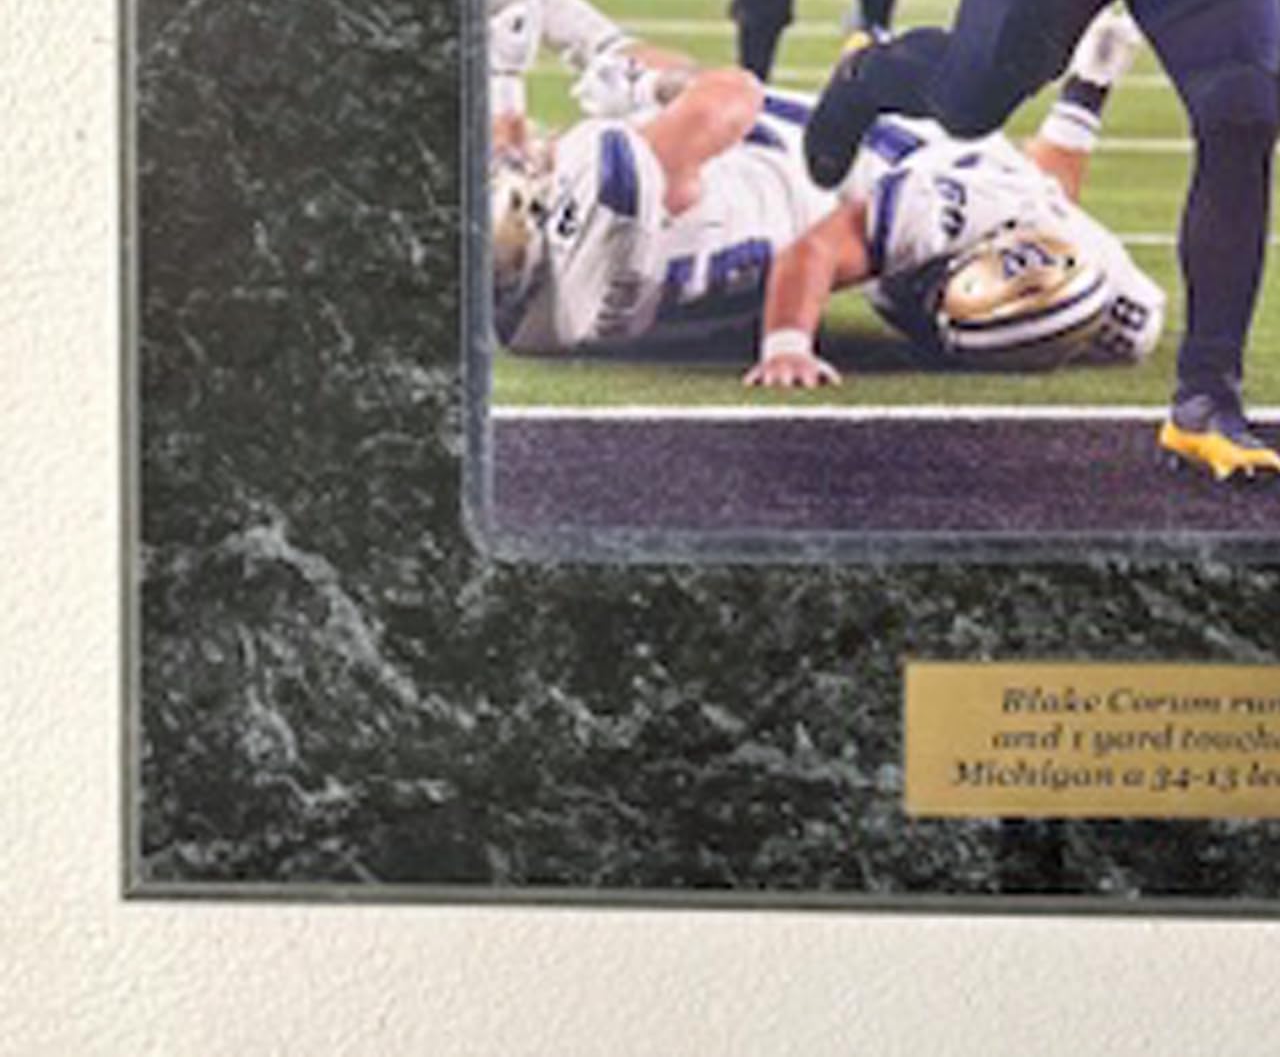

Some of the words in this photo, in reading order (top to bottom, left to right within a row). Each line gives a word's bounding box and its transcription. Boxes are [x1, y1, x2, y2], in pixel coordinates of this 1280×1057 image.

[1002, 686, 1101, 713] Blake
[1106, 688, 1221, 714] Corum
[992, 723, 1063, 750] and
[1092, 723, 1174, 757] yard
[952, 758, 1115, 791] Michigan
[1123, 769, 1145, 788] a
